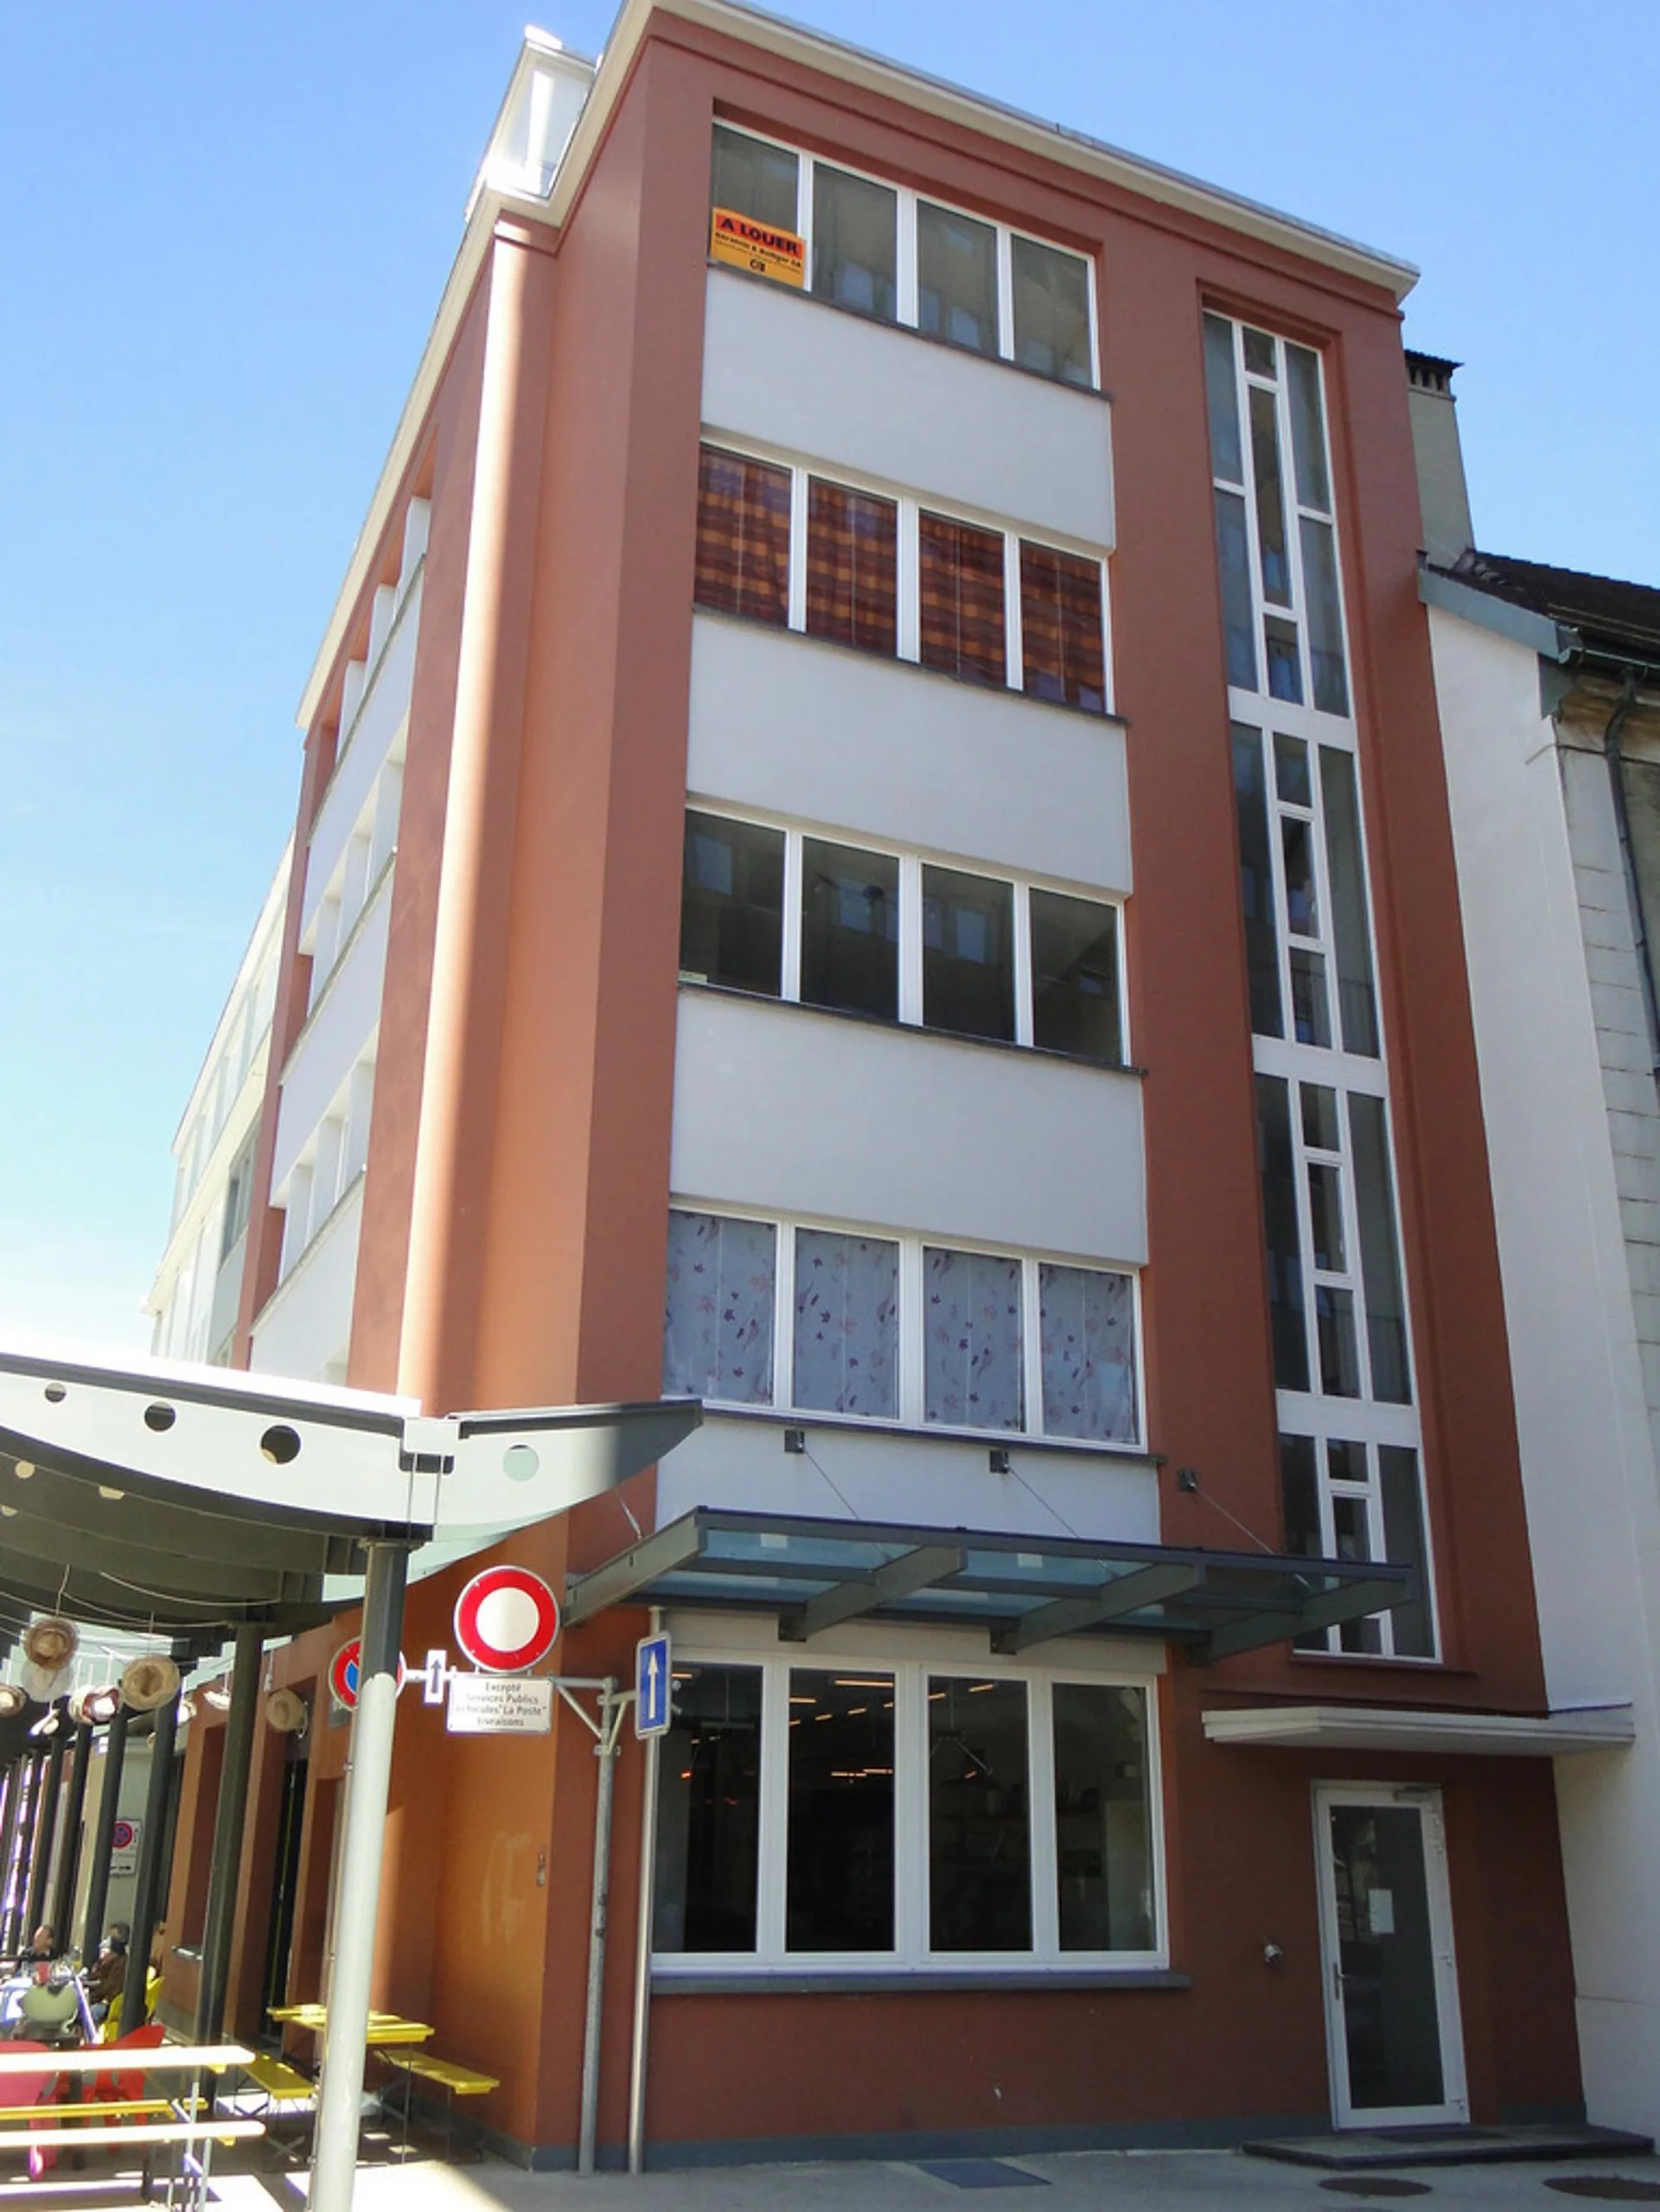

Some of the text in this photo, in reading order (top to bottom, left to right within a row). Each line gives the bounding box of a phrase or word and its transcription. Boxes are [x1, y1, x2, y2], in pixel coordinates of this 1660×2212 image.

[721, 217, 734, 231] A
[740, 223, 797, 255] LOUER
[506, 1693, 539, 1705] Publics
